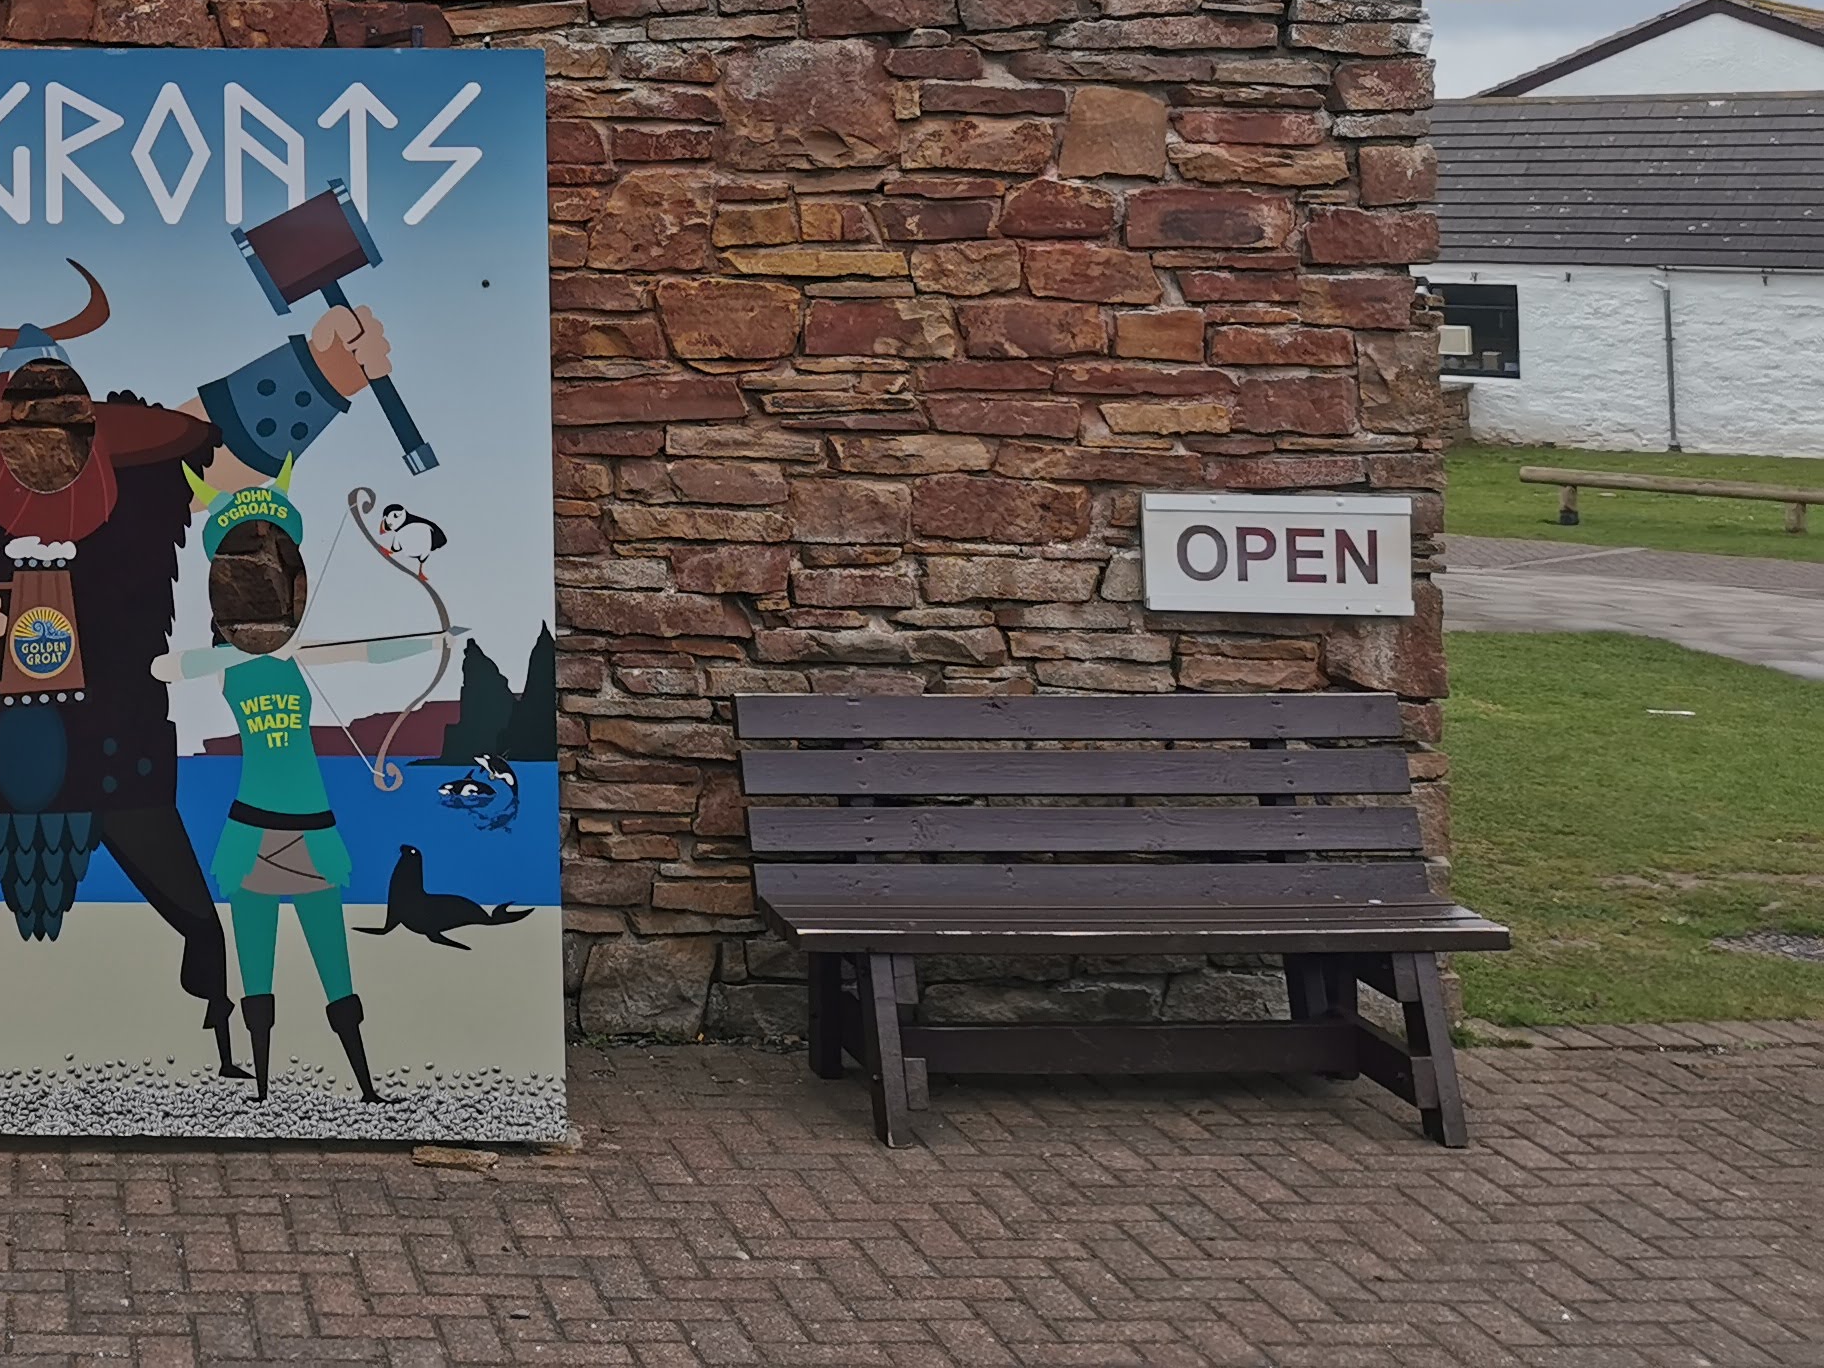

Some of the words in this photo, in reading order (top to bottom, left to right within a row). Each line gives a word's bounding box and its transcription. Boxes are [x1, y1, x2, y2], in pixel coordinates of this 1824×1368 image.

[234, 489, 272, 505] JOHN
[217, 502, 288, 527] O'GROATS
[1176, 524, 1379, 585] OPEN
[21, 641, 67, 654] GOLDEN
[26, 652, 63, 665] GROAT
[240, 694, 301, 715] WE'VE
[246, 713, 302, 734] MADE
[266, 732, 289, 748] IT!
